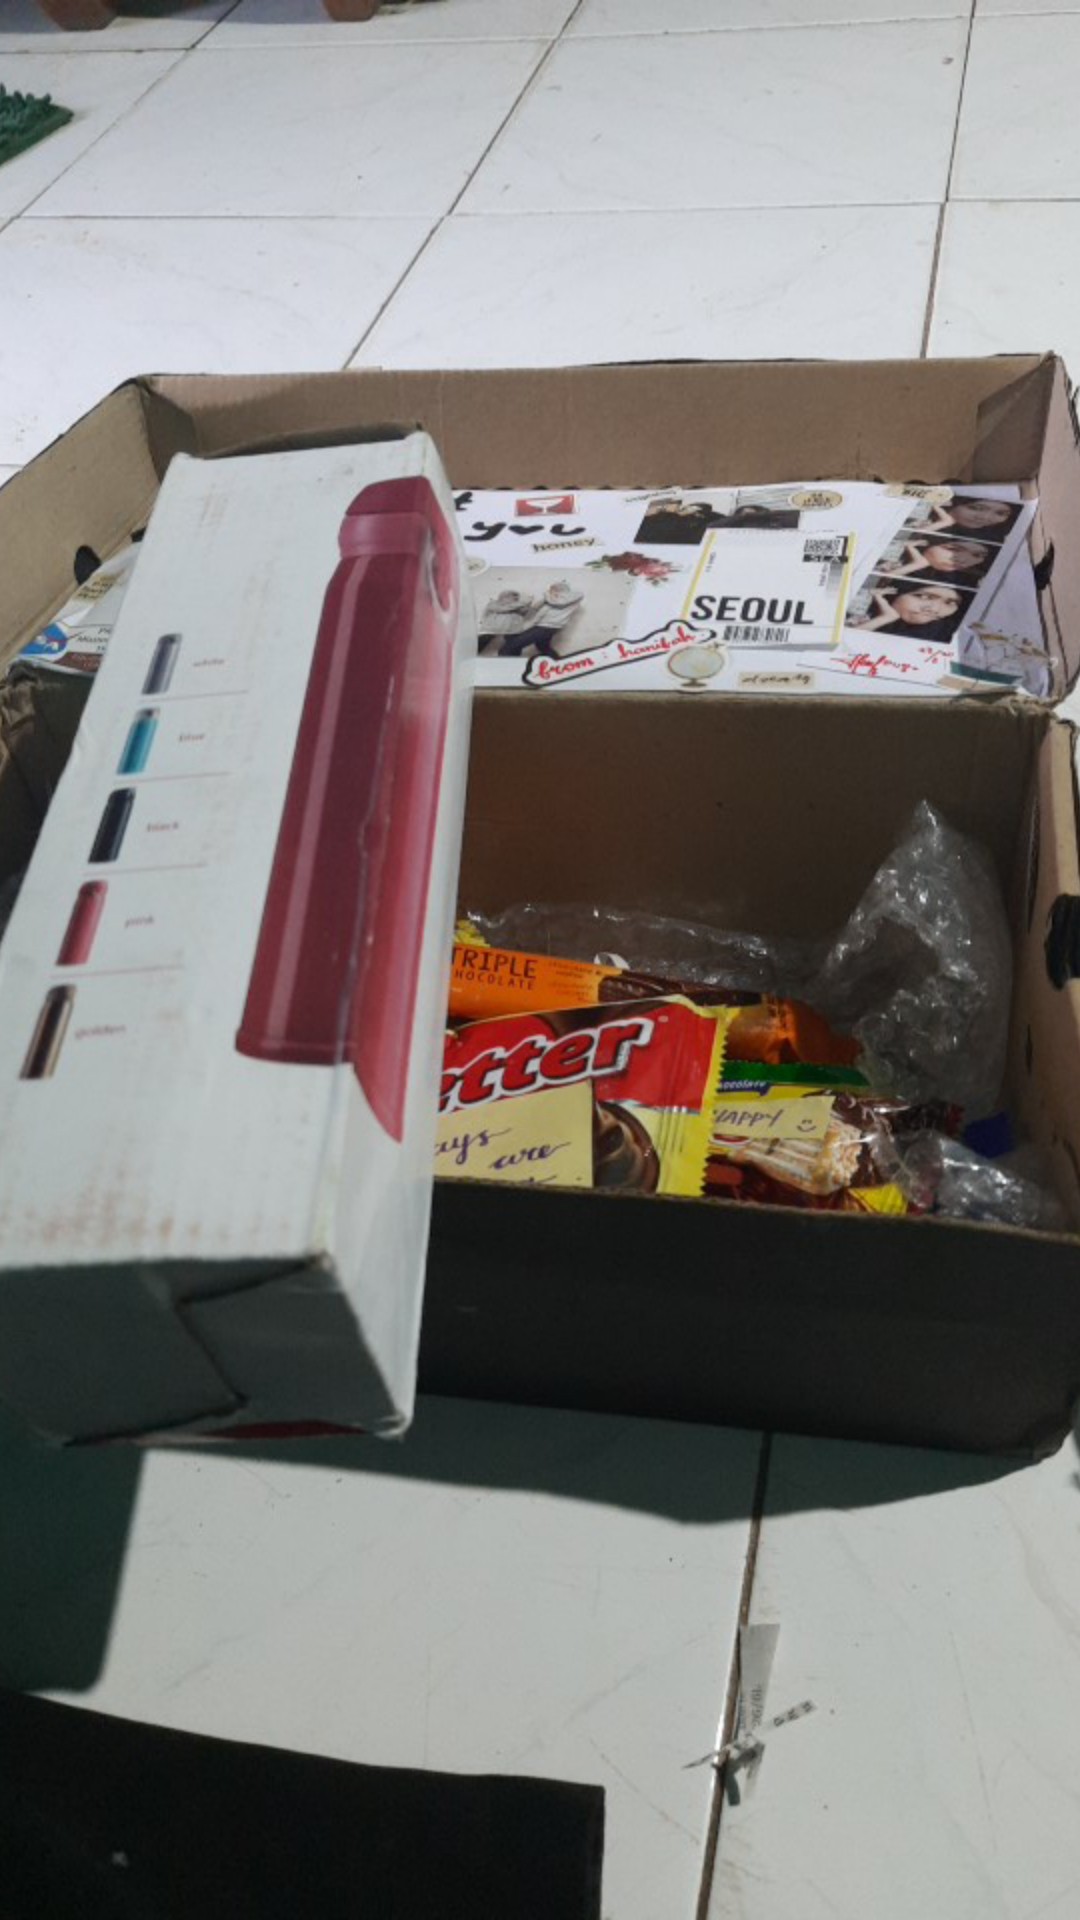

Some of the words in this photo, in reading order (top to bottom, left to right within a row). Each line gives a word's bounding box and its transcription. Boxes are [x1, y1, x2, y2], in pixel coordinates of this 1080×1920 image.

[532, 538, 596, 553] honey
[690, 595, 815, 625] SEOUL
[454, 968, 535, 991] HOCOLATE
